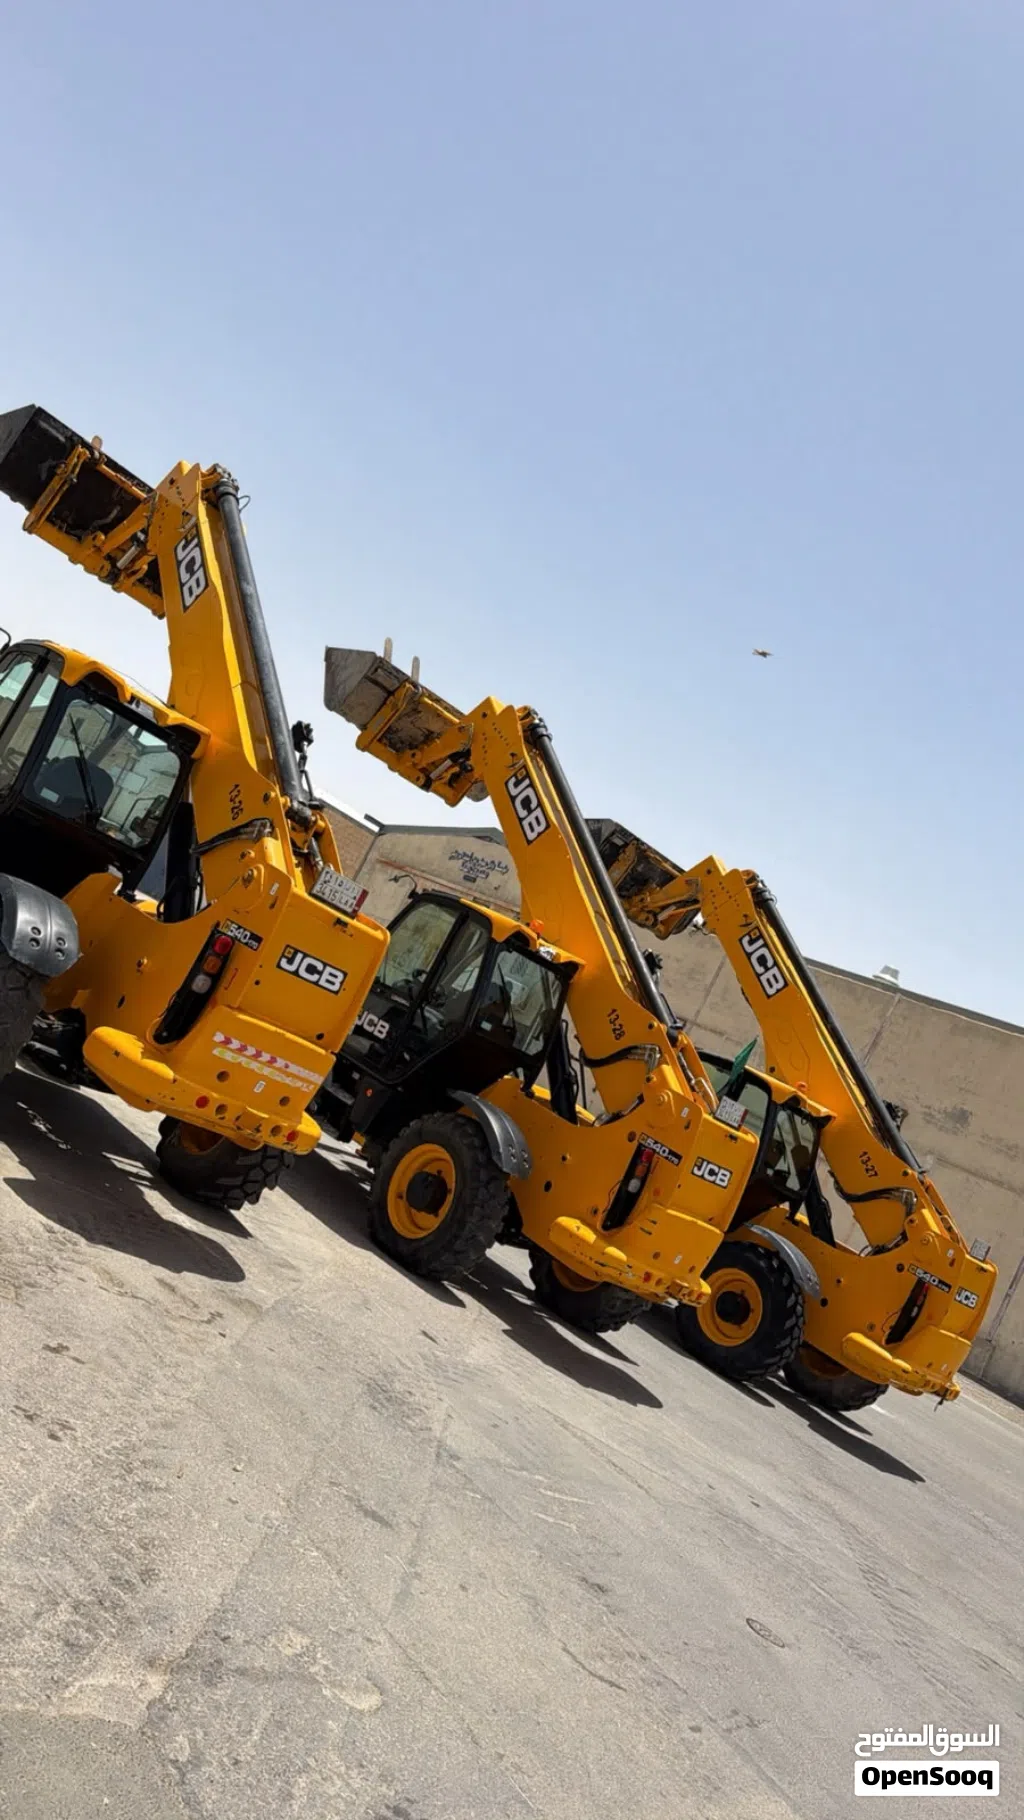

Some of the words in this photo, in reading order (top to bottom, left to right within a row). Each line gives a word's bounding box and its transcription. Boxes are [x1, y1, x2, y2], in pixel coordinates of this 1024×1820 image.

[175, 536, 207, 608] JCB
[506, 775, 547, 841] JCB
[279, 951, 345, 992] JCB
[741, 934, 786, 996] JCB
[355, 1010, 390, 1039] JCB
[692, 1160, 732, 1188] JCB
[859, 1151, 879, 1178] 13-27
[955, 1288, 979, 1308] JCB
